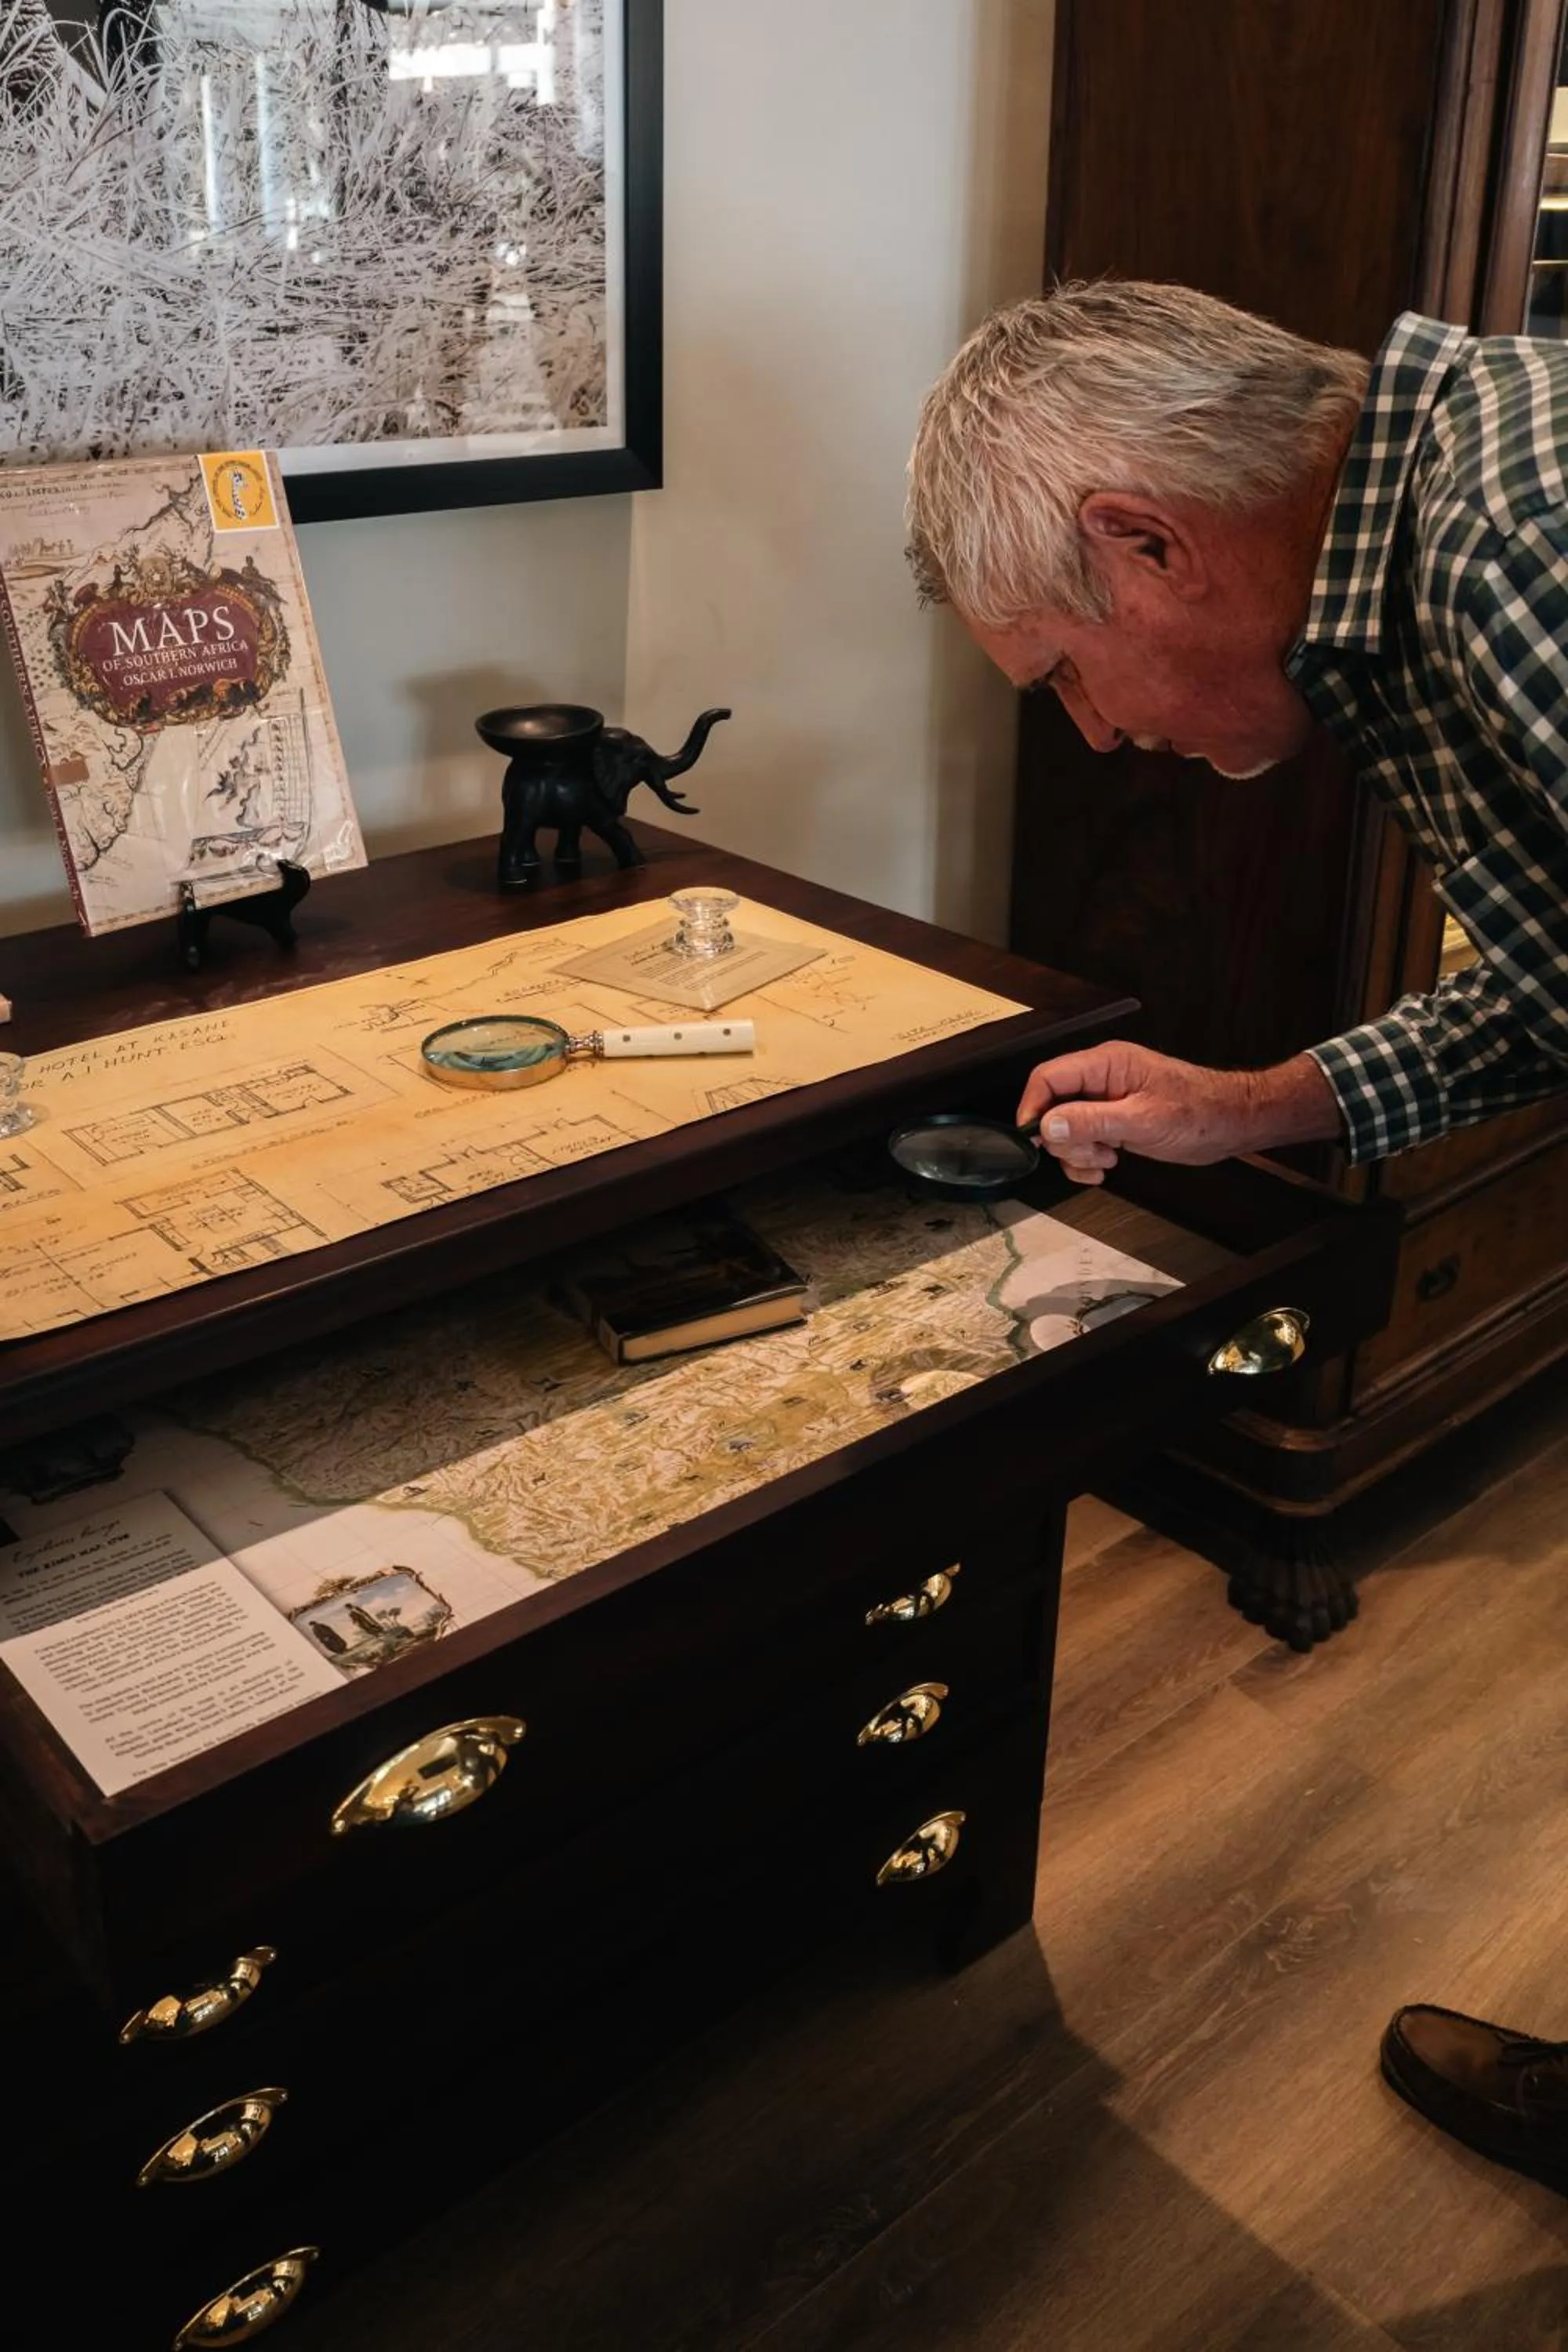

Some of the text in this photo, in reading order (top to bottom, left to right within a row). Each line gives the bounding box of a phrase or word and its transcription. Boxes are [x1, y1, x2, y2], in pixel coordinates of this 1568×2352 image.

[107, 605, 235, 657] MAPS
[103, 639, 249, 673] OF SOUTHERN AFRICA
[122, 672, 168, 686] OSCAR
[177, 658, 238, 677] NORWICH
[39, 1051, 101, 1074] HOTEL
[115, 1040, 139, 1053] AT
